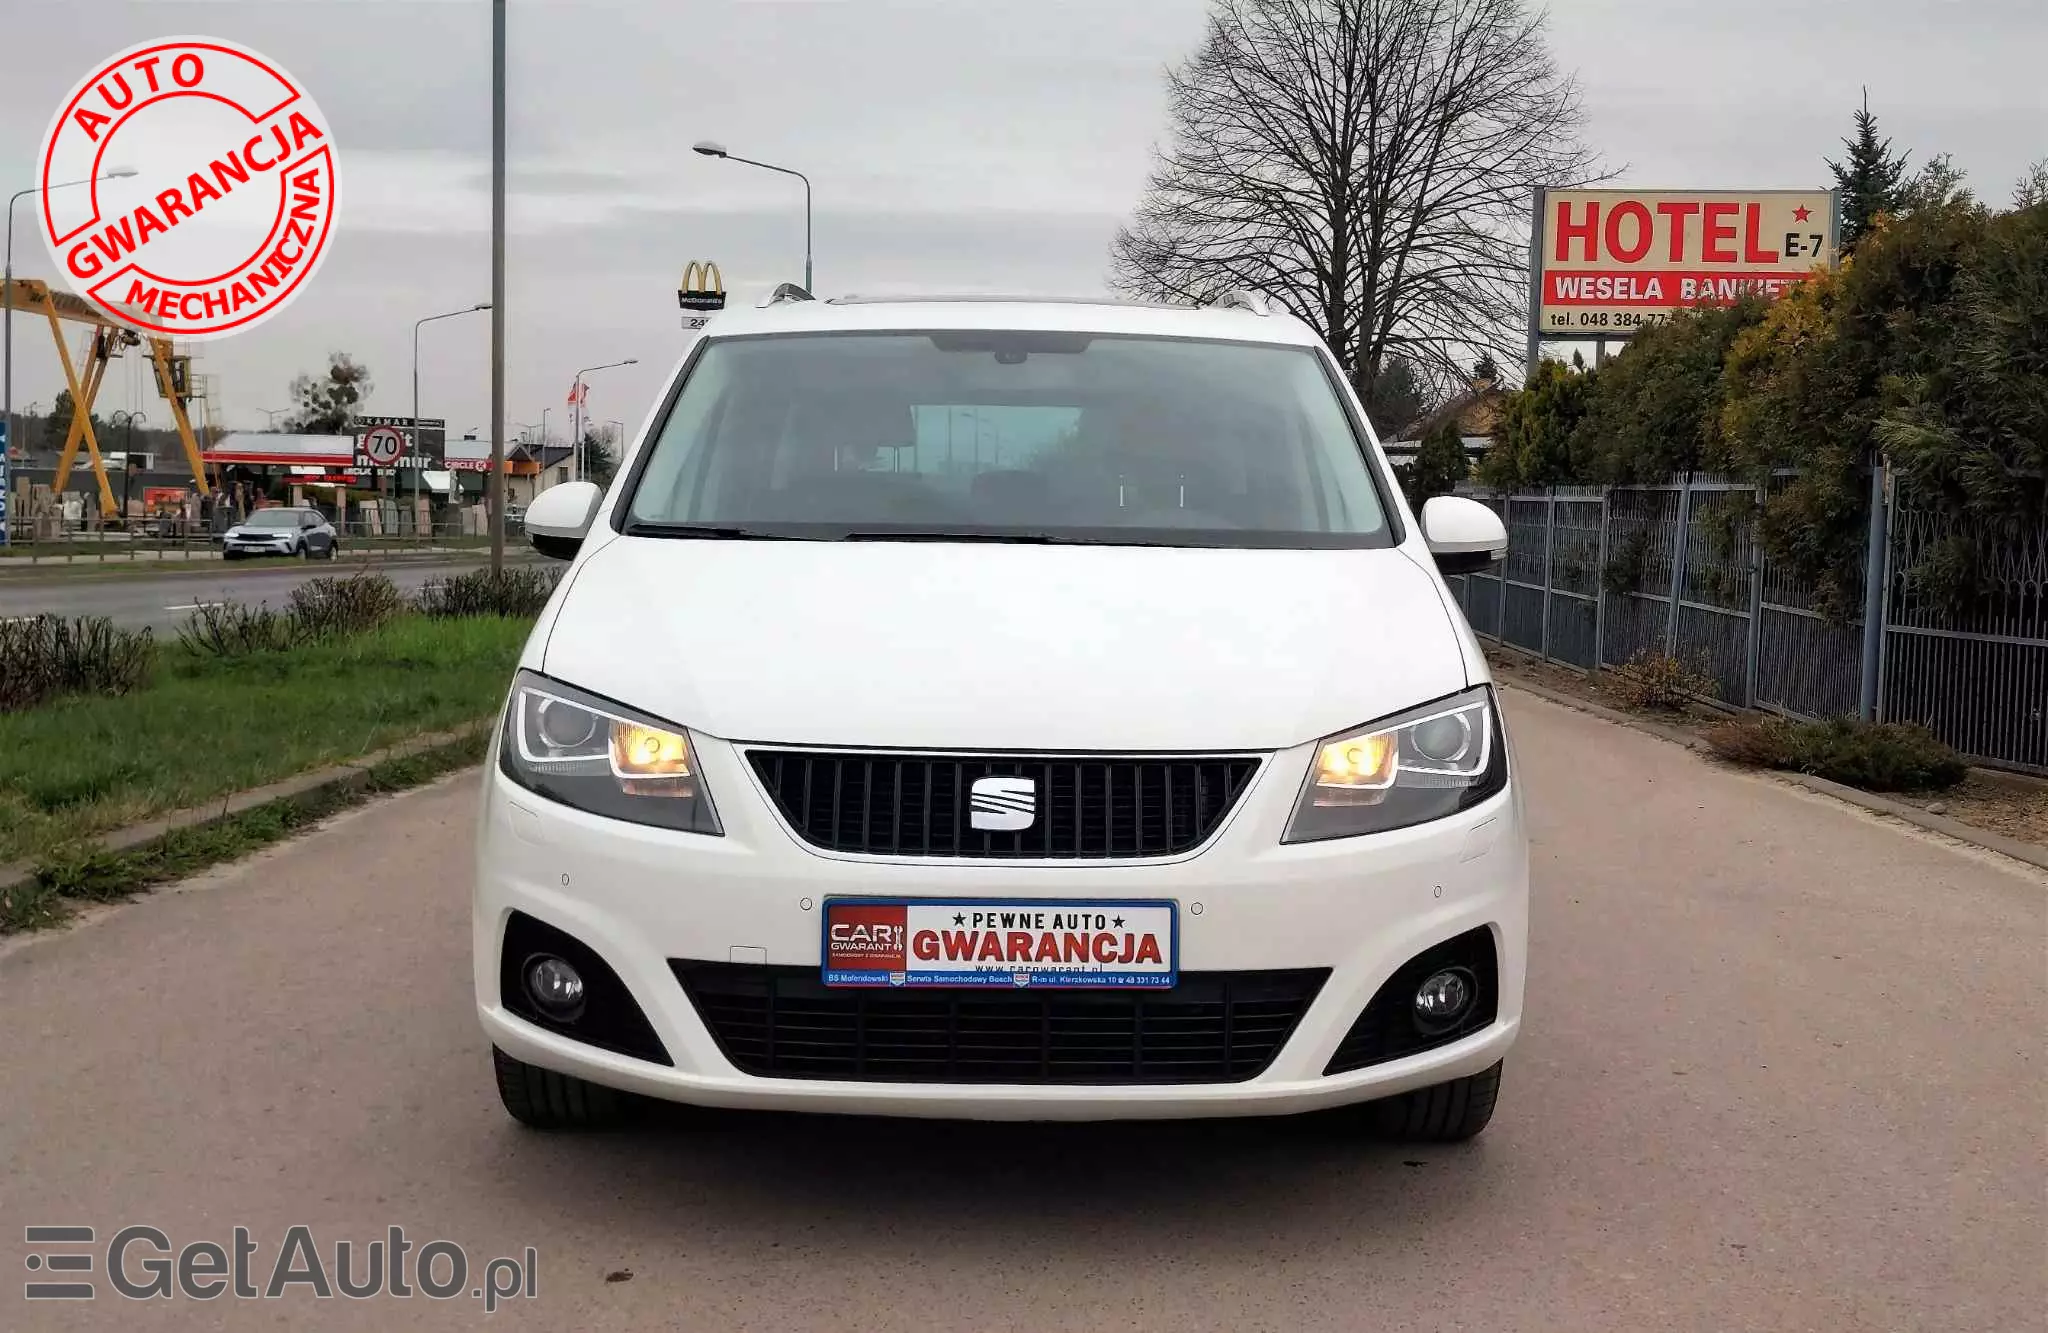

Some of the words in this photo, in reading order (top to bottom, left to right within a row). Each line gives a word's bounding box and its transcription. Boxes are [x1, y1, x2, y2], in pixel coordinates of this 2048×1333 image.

[1555, 201, 1779, 264] HOTEL
[1785, 233, 1824, 258] E-7
[1555, 277, 1664, 300] WESELA
[1550, 312, 1574, 326] tel.
[1580, 312, 1608, 326] 048
[1613, 313, 1642, 326] 384
[372, 435, 398, 455] 70
[444, 461, 475, 469] CIRCLE
[972, 912, 1045, 929] PEWNE
[1052, 913, 1106, 930] AUTO
[831, 924, 892, 942] CAR
[831, 942, 892, 951] GWARANT
[912, 930, 1163, 964] GWARANCJA
